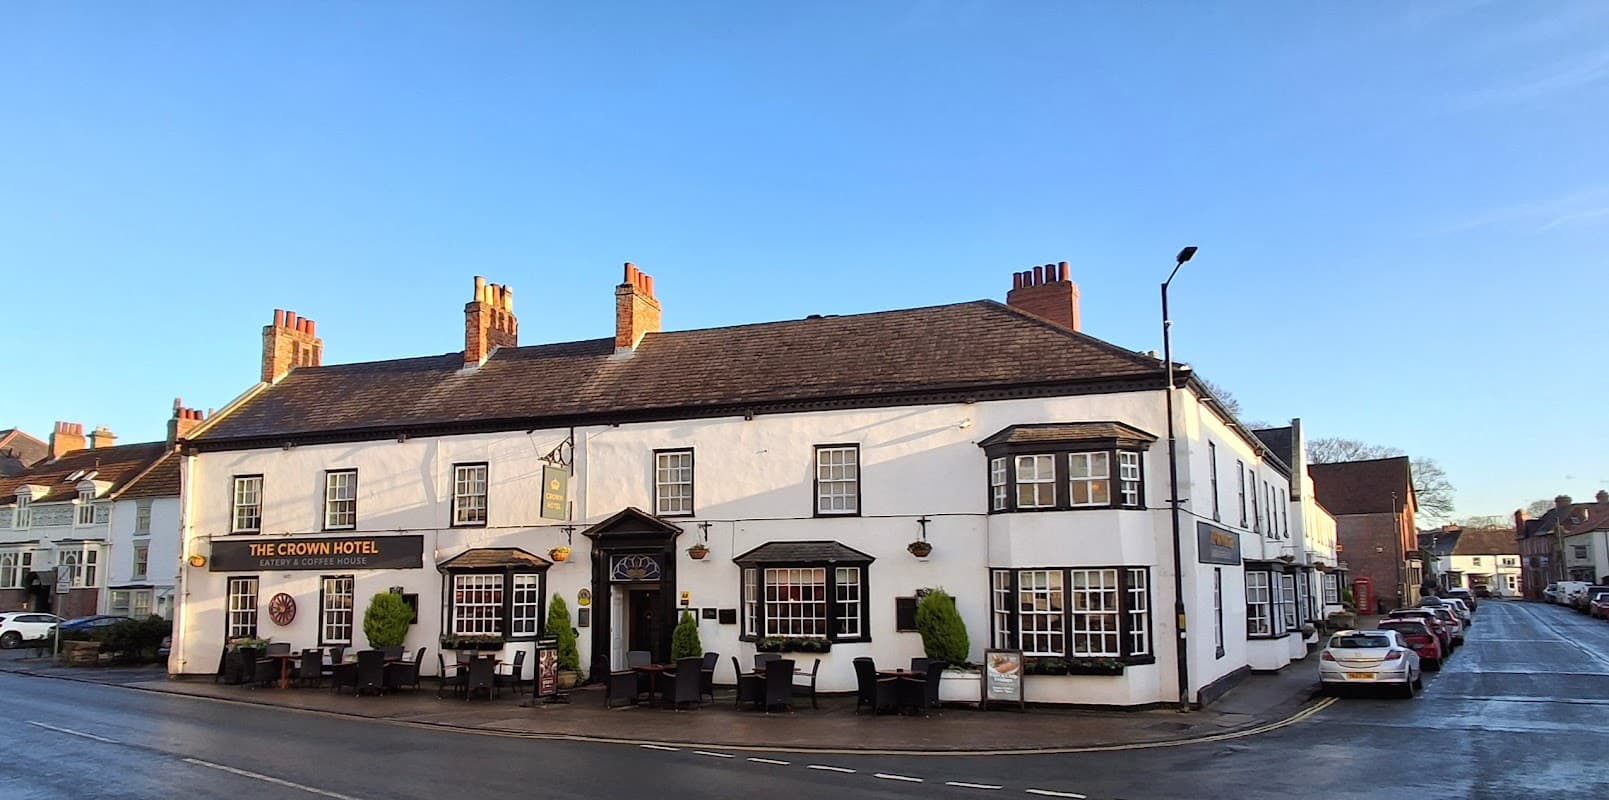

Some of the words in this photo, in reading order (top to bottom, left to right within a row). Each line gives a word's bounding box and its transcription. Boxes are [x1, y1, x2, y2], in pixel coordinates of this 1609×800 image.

[249, 543, 275, 556] THE
[278, 542, 330, 556] CROWN
[333, 540, 379, 554] HOTEL
[259, 559, 290, 567] EATERY
[293, 558, 299, 566] &
[301, 558, 335, 566] COFFEE
[337, 557, 367, 565] HOUSE
